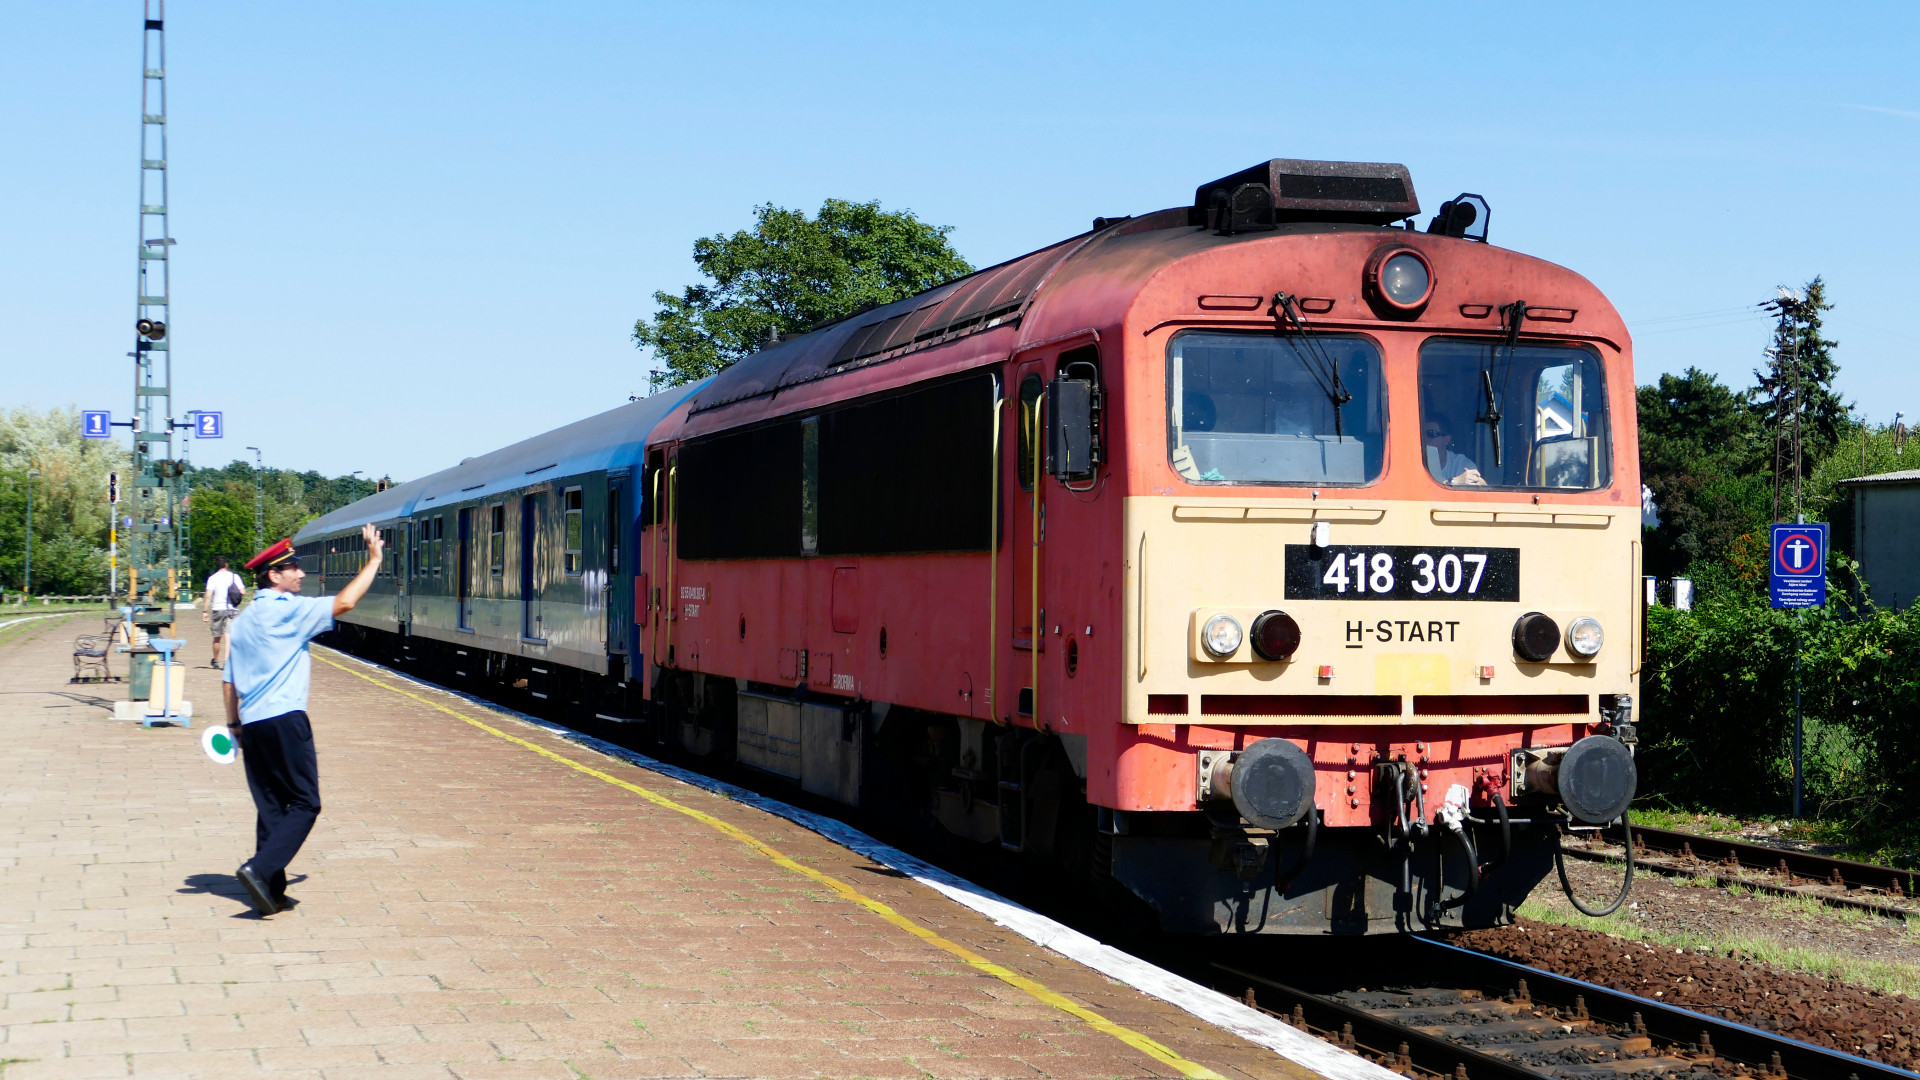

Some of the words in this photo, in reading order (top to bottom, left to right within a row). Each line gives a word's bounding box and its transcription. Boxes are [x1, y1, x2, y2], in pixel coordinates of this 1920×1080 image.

[91, 415, 102, 430] 1
[202, 416, 215, 430] 2
[1323, 552, 1395, 593] 418
[1411, 553, 1488, 593] 307
[1346, 620, 1460, 644] H-START
